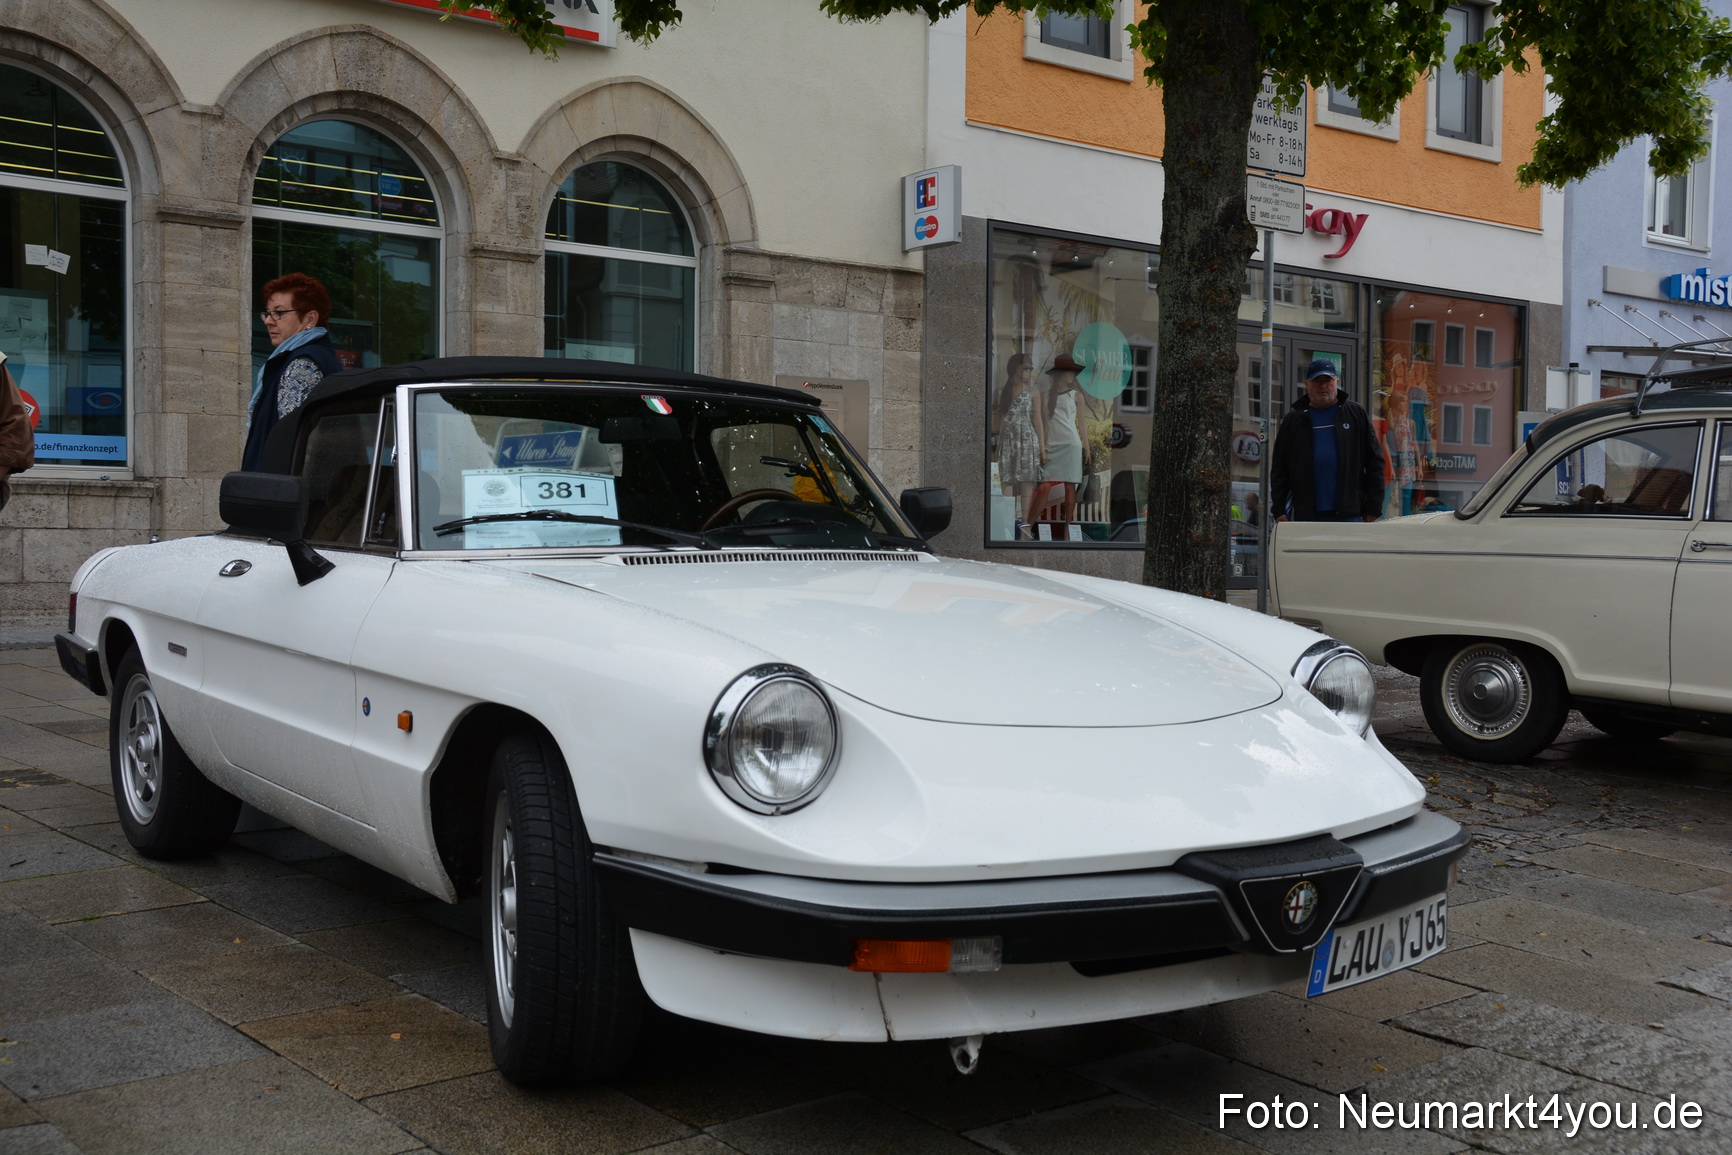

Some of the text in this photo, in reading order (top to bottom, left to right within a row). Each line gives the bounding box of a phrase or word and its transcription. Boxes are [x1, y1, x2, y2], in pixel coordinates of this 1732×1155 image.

[1255, 114, 1298, 133] werktags
[1249, 130, 1276, 145] Mo-Fr
[1249, 147, 1260, 160] Sa
[1275, 184, 1295, 194] Parkschein
[1250, 194, 1262, 202] Anruf
[1260, 211, 1270, 219] SMS
[916, 224, 937, 233] Maestro
[1075, 349, 1129, 367] SUMMER
[1437, 380, 1505, 402] orsay
[516, 438, 547, 460] Uhren
[538, 481, 586, 500] 381
[1328, 923, 1385, 985] LAU
[1313, 969, 1322, 984] D
